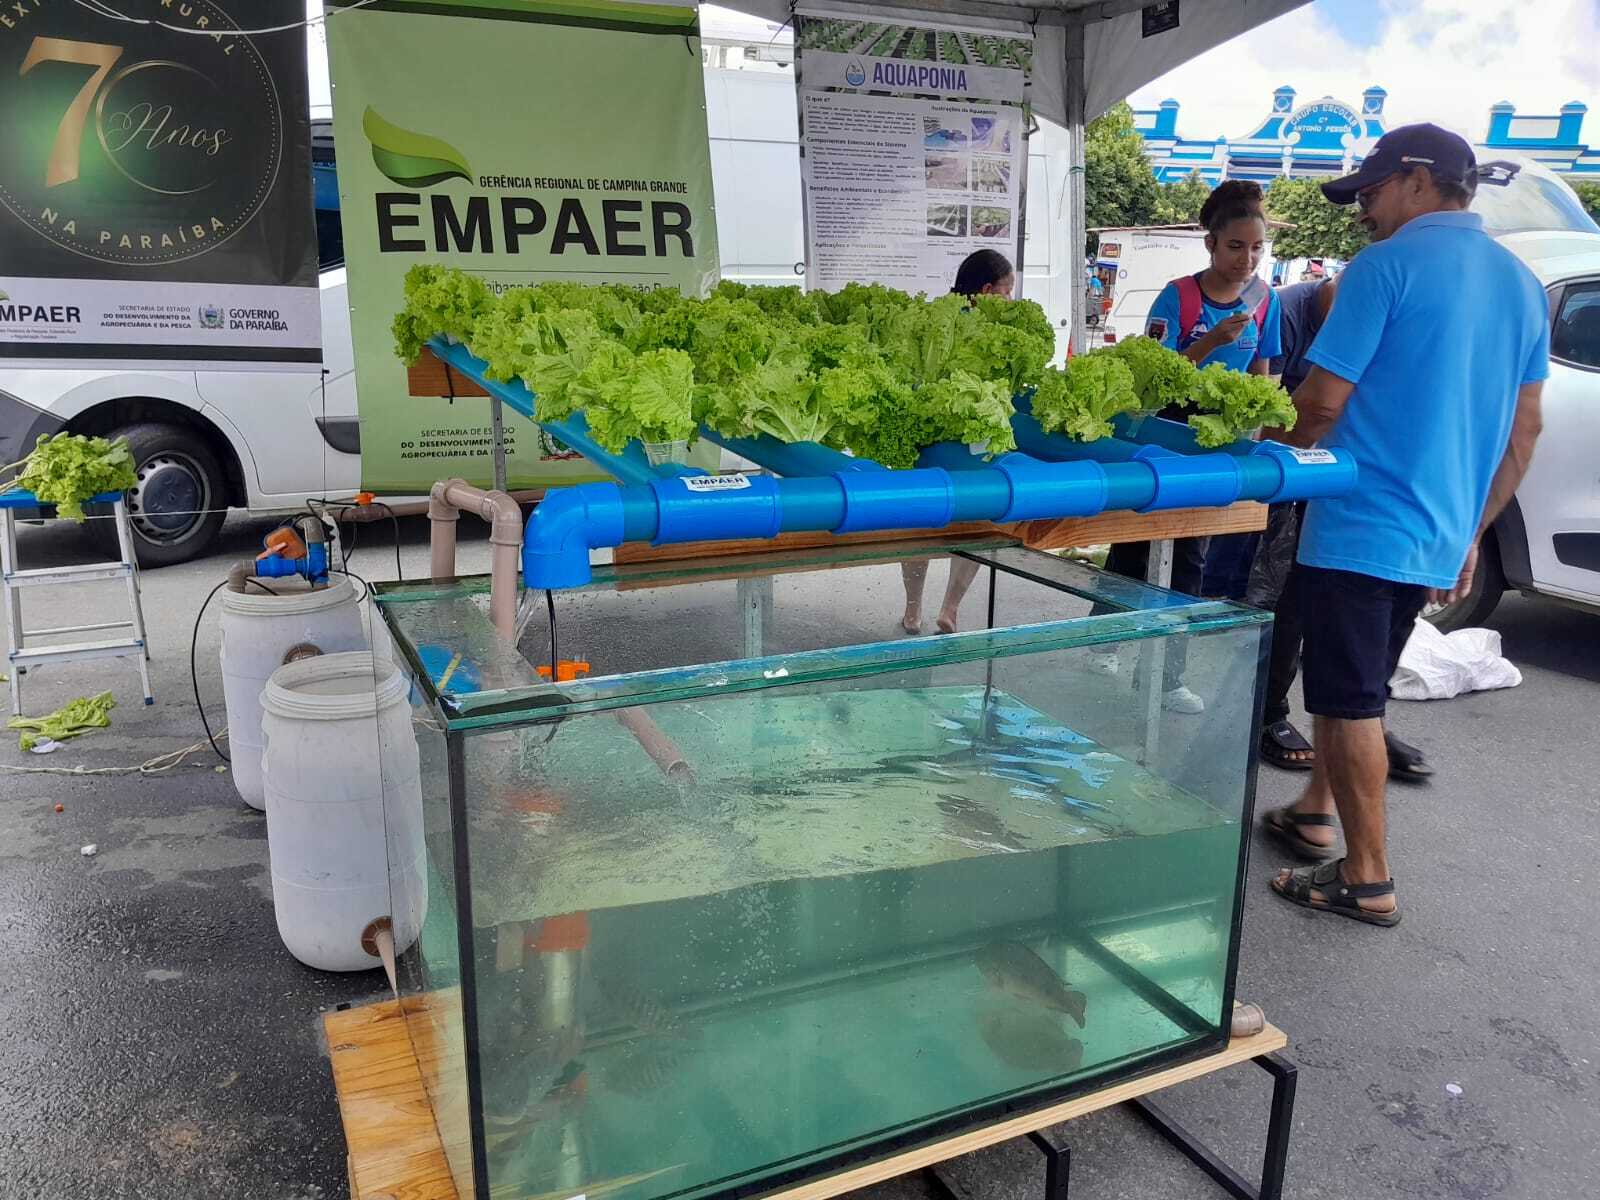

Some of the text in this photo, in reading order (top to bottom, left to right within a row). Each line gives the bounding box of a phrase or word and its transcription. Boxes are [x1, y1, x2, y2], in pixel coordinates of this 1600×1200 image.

[873, 62, 968, 91] AQUAPONIA
[106, 102, 232, 155] Anos
[480, 175, 688, 194] GERÊNCIA REGIONAL DE CAMPINA GRANDE
[41, 208, 225, 249] NA PARAÍBA
[375, 192, 695, 257] EMPAER
[0, 304, 81, 323] MPAER
[229, 308, 279, 319] GOVERNO
[230, 318, 289, 331] DA PARAÍBA
[421, 429, 468, 438] SECRETARIA
[484, 427, 515, 435] ESDO
[401, 441, 414, 449] DO
[420, 438, 495, 448] DESENVOLVIMENT
[690, 477, 745, 485] EMPAER
